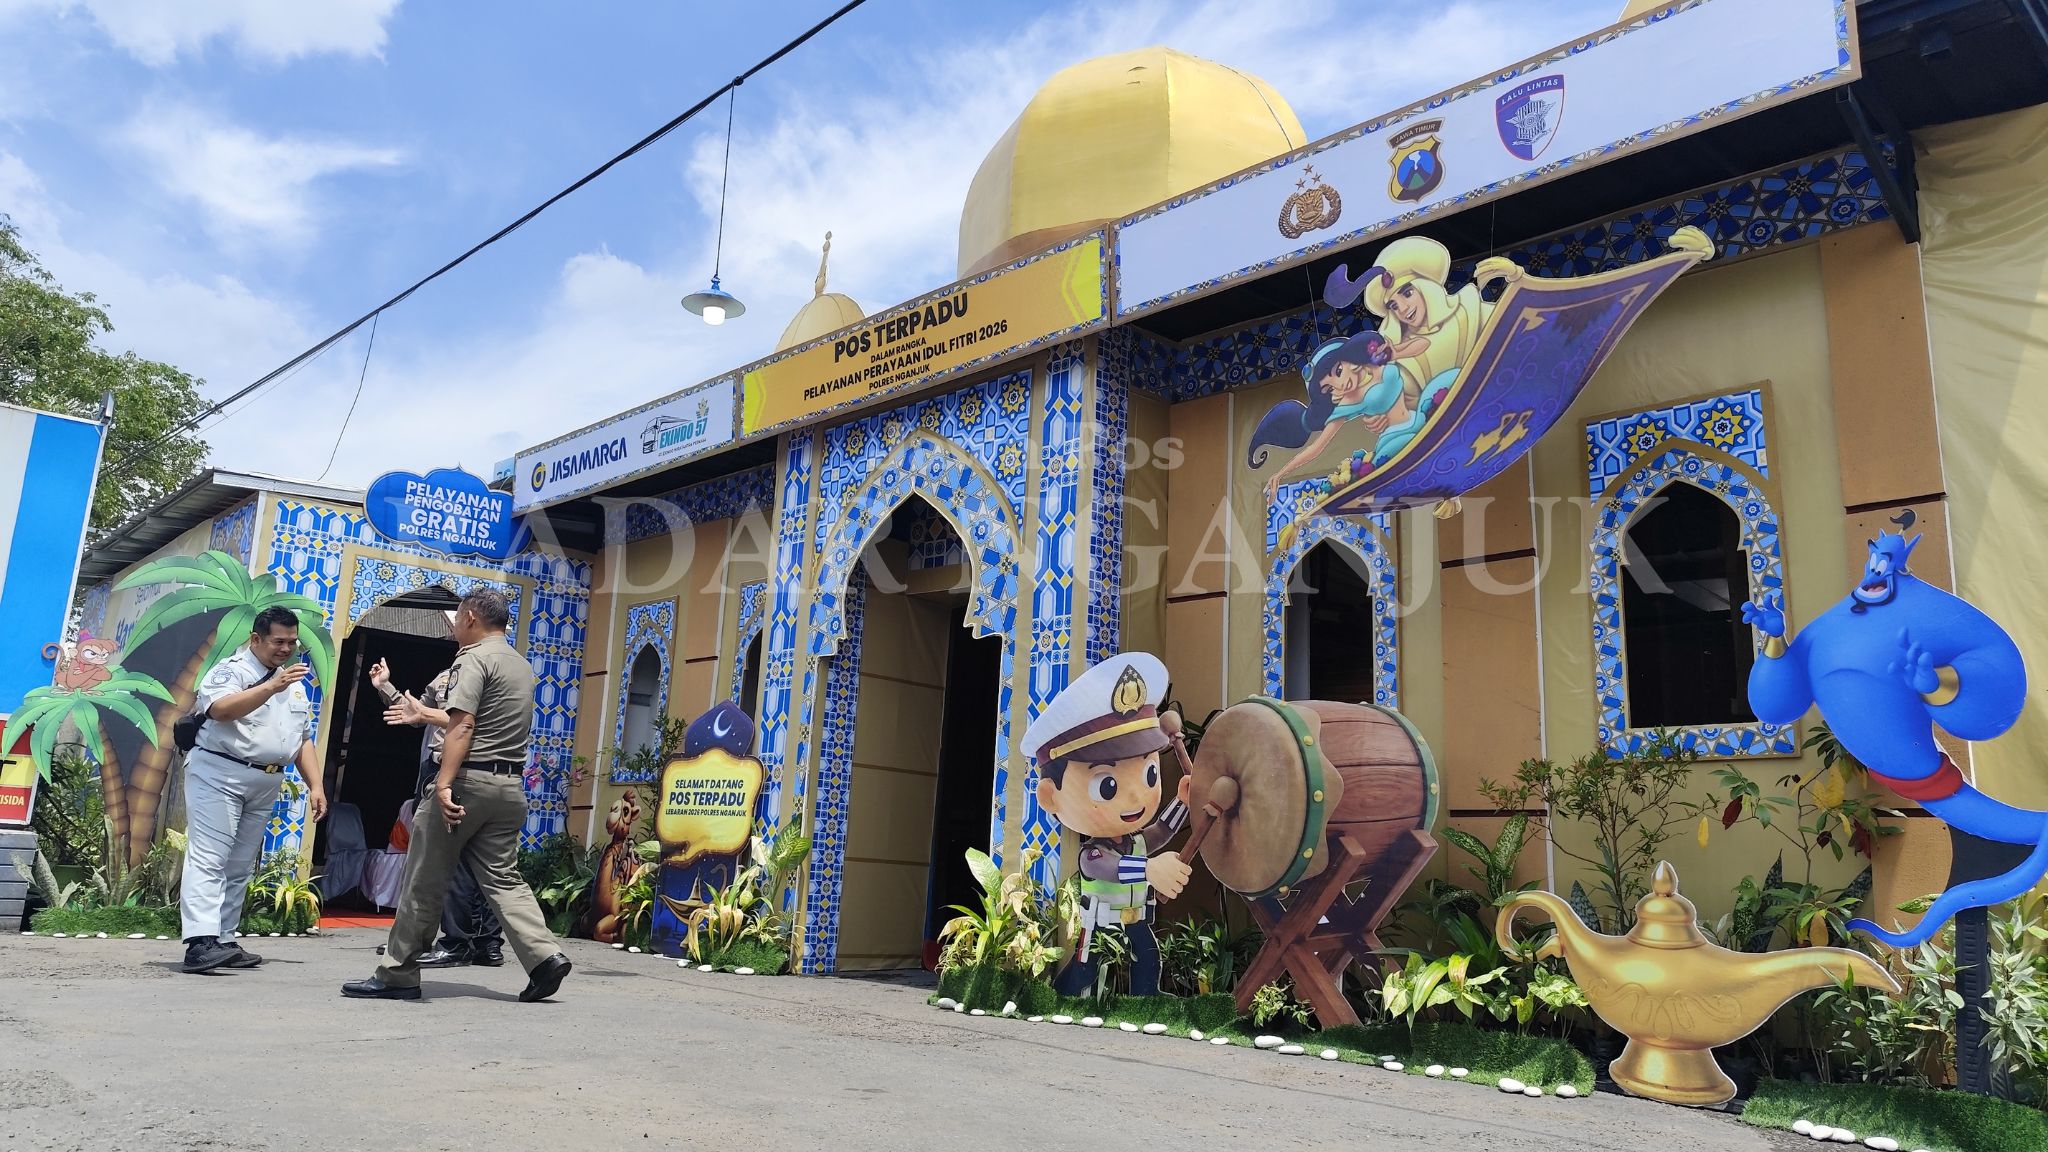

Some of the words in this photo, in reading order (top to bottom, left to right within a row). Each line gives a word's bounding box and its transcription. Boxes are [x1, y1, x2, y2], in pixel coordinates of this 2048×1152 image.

[1501, 89, 1523, 105] LALU
[1526, 78, 1559, 92] LINTAS
[1395, 130, 1414, 144] JAWA
[1415, 123, 1436, 133] TIMUR
[834, 330, 871, 363] POS
[874, 292, 968, 347] TERPADU
[803, 371, 862, 401] PELAYANAN
[863, 352, 921, 380] PERAYAAN
[922, 343, 948, 361] IDUL
[949, 330, 977, 352] FITRI
[978, 319, 1008, 341] 2026
[870, 347, 895, 363] DALAM
[895, 337, 927, 355] RANGKA
[869, 376, 894, 390] POLRES
[895, 363, 931, 382] NGANJUK
[659, 422, 694, 449] EXINDO
[695, 417, 709, 436] 57
[549, 436, 628, 483] JASAMARGA
[404, 494, 500, 523] PENGOBATAN
[406, 480, 502, 513] PELAYANAN
[399, 523, 441, 540] POLRES
[442, 533, 497, 550] NGANJUK
[410, 509, 491, 539] GRATIS
[675, 779, 709, 789] SELAMAT
[710, 779, 744, 789] DATANG
[665, 808, 688, 816] LEBARAN
[669, 791, 691, 805] POS
[693, 792, 746, 807] TERPADU
